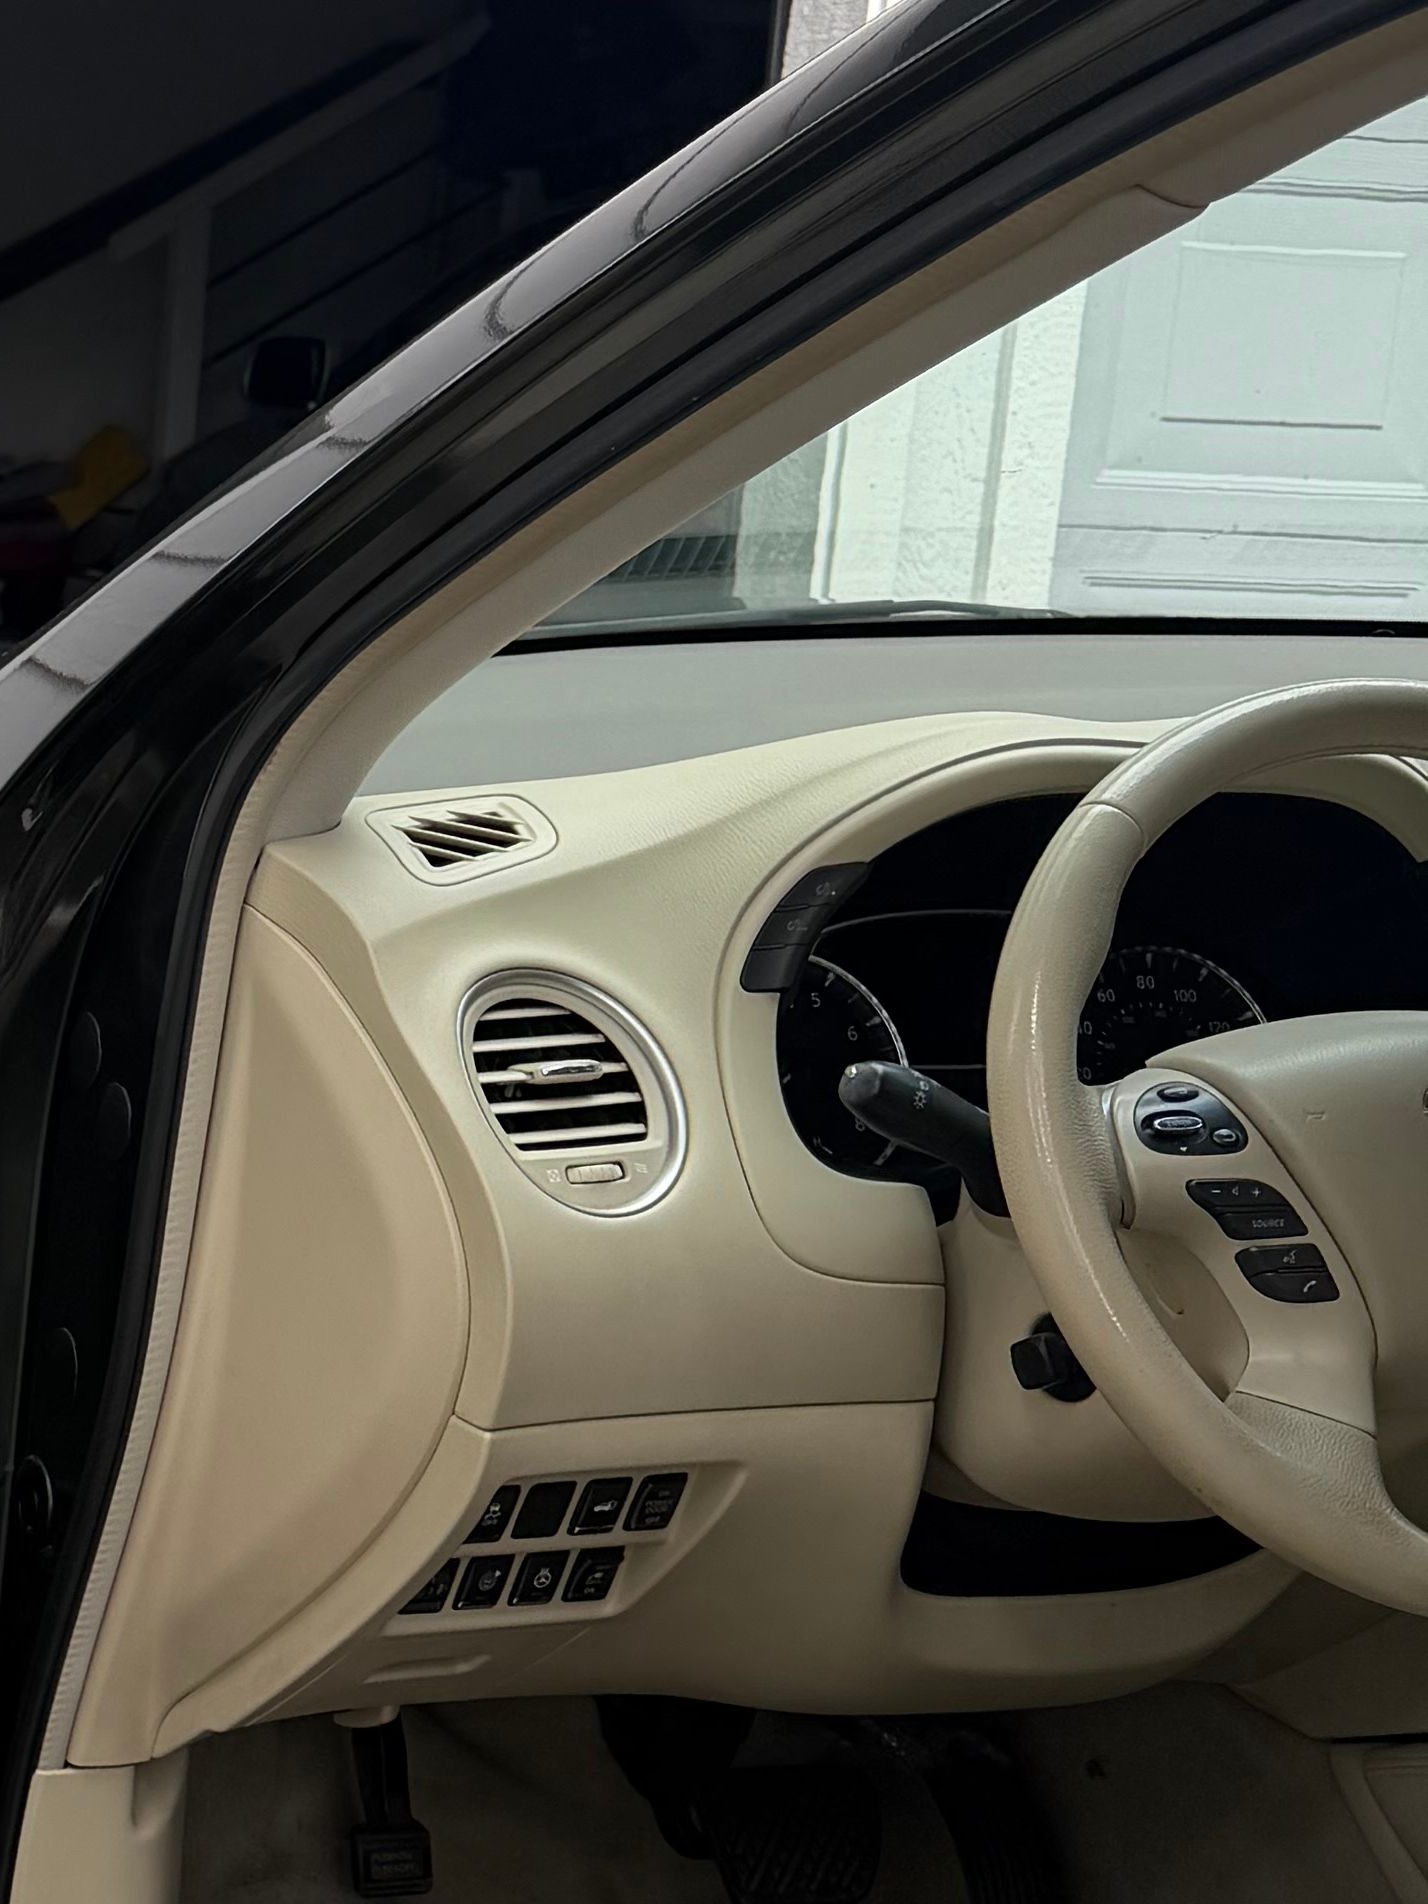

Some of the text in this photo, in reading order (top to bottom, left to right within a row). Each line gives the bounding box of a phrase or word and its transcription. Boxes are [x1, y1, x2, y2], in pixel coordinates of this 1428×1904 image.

[1135, 975, 1155, 989] 80
[810, 992, 822, 1008] 5
[1096, 988, 1116, 1003] 60
[1172, 988, 1197, 1003] 100
[847, 1025, 858, 1041] 6
[1252, 1218, 1285, 1228] SOURCE
